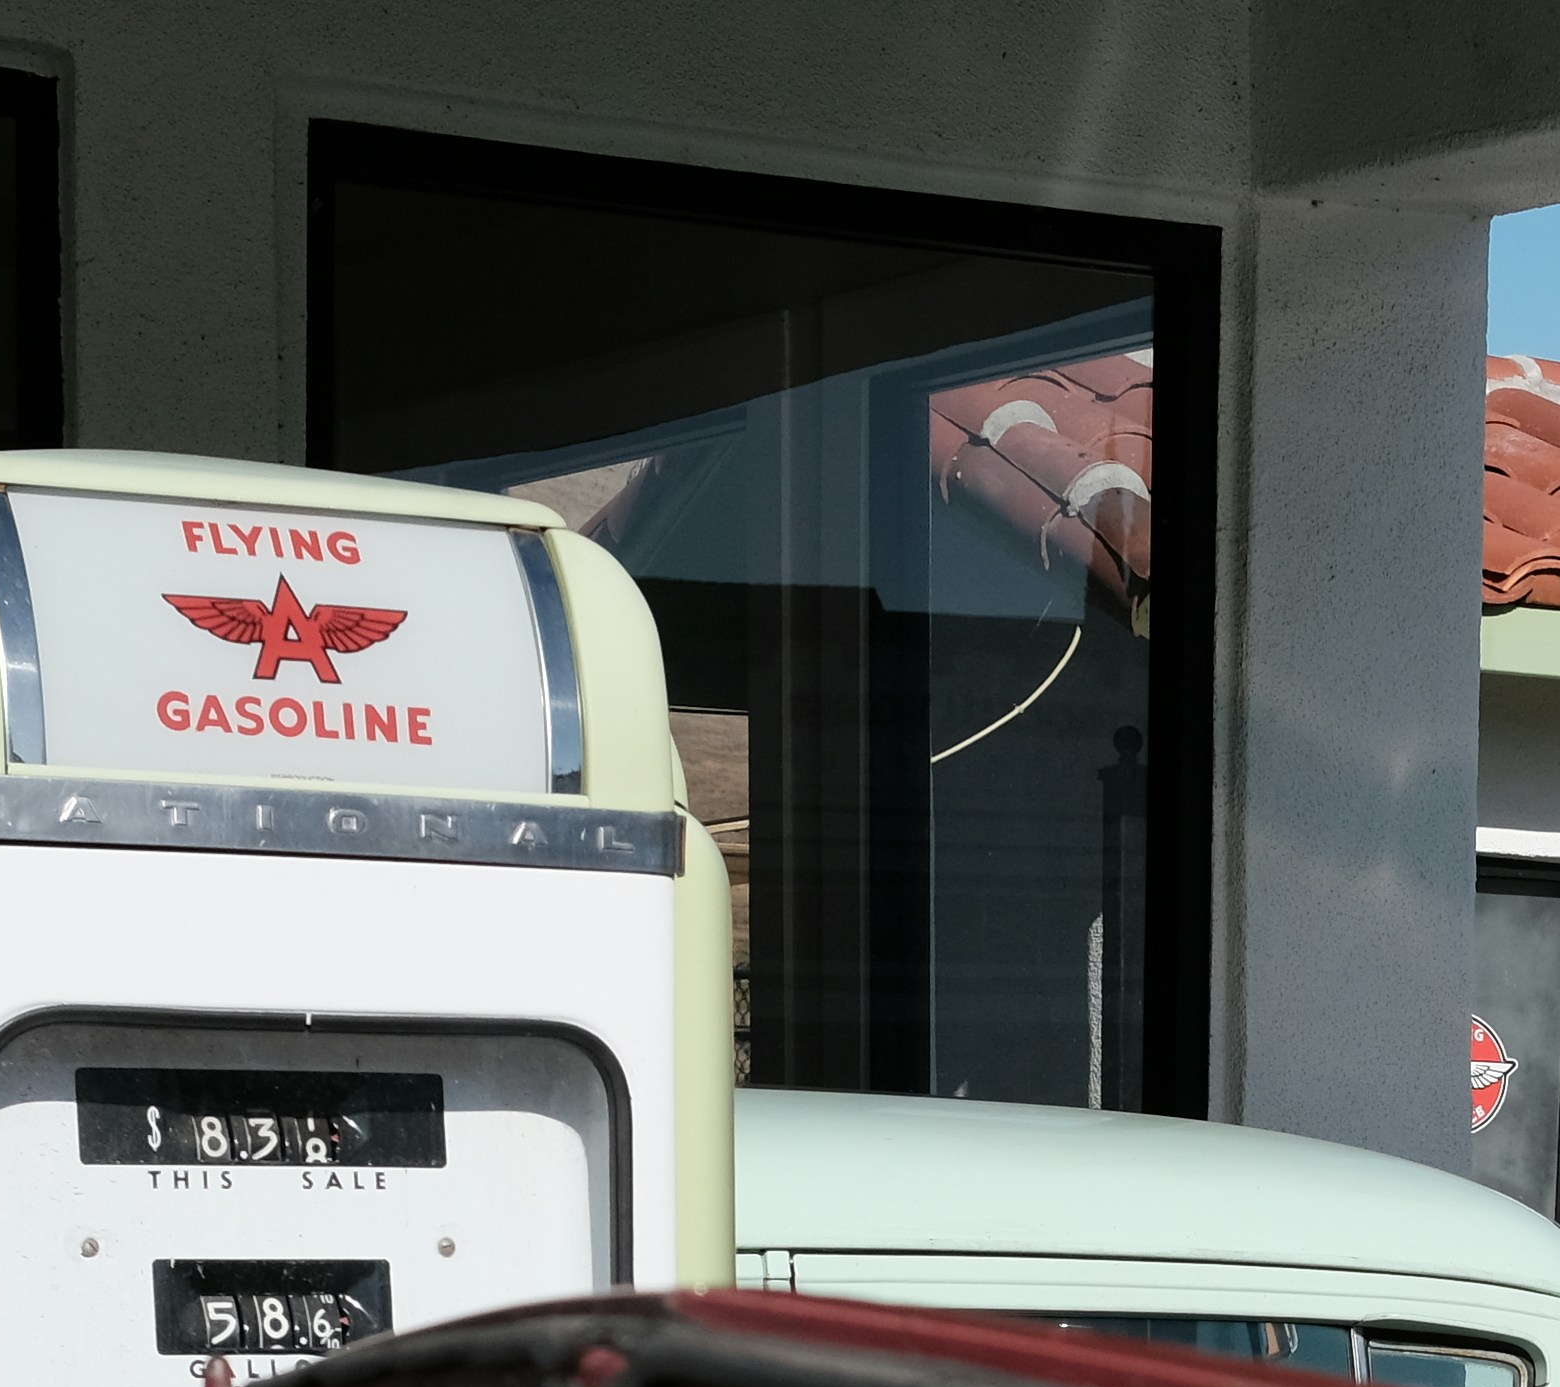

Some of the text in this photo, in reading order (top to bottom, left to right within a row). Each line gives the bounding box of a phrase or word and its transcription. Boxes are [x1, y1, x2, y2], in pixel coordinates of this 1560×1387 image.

[182, 521, 361, 565] FLYING
[157, 691, 433, 745] GASOLINE
[148, 1170, 386, 1190] THIS SALE
